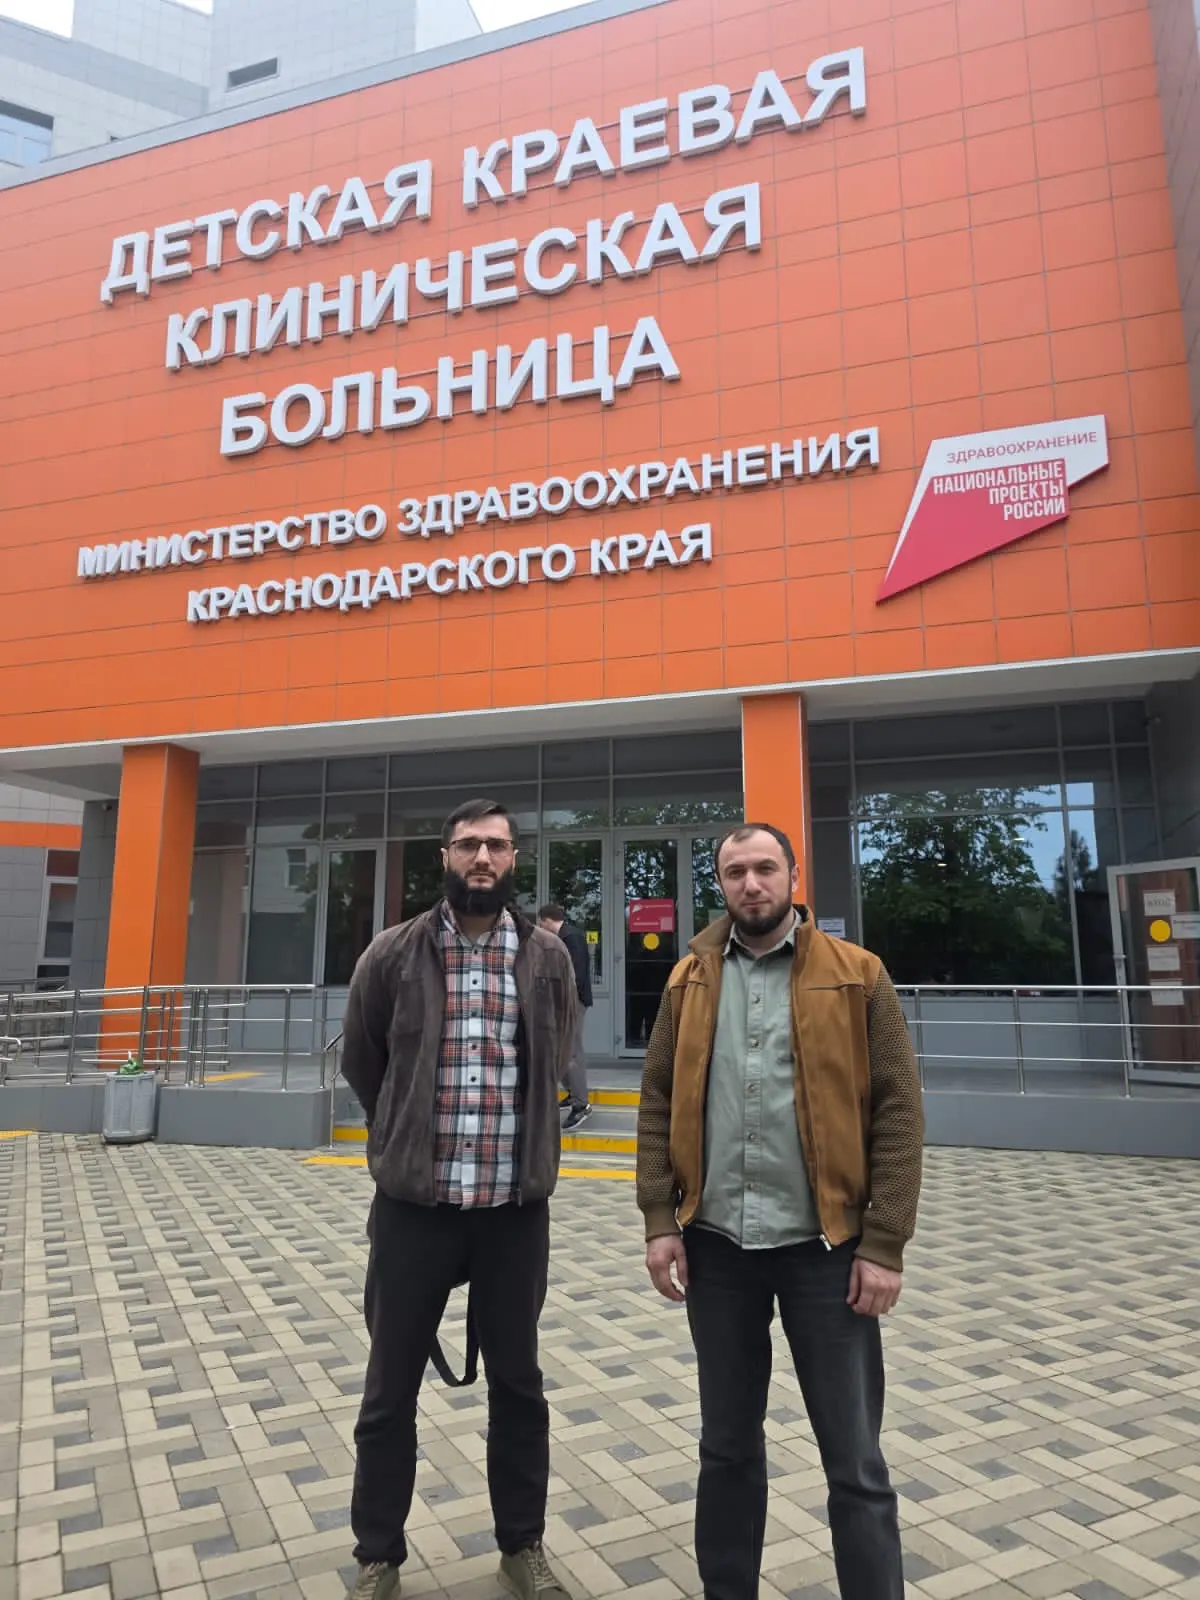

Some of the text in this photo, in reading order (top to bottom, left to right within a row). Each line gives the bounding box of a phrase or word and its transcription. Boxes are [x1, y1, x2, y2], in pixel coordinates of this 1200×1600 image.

[101, 47, 867, 303] ДЕТСКАЯ КРАЕВАЯ
[165, 182, 762, 371] КЛИНИЧЕСКАЯ
[220, 316, 681, 458] БОЛЬНИЦА
[933, 461, 1063, 495] НАЦИОНАЛЬНЫЕ
[946, 431, 1097, 464] ЗДРАВООХРАНЕНИЕ
[989, 480, 1064, 505] ПРОЕКТЫ
[77, 426, 880, 578] МИНИСТЕРСТВО ЗДРАВООХРАНЕНИЯ
[1003, 497, 1065, 521] РОССИИ
[186, 522, 713, 623] КРАСНОДАРСКОГО КРАЯ
